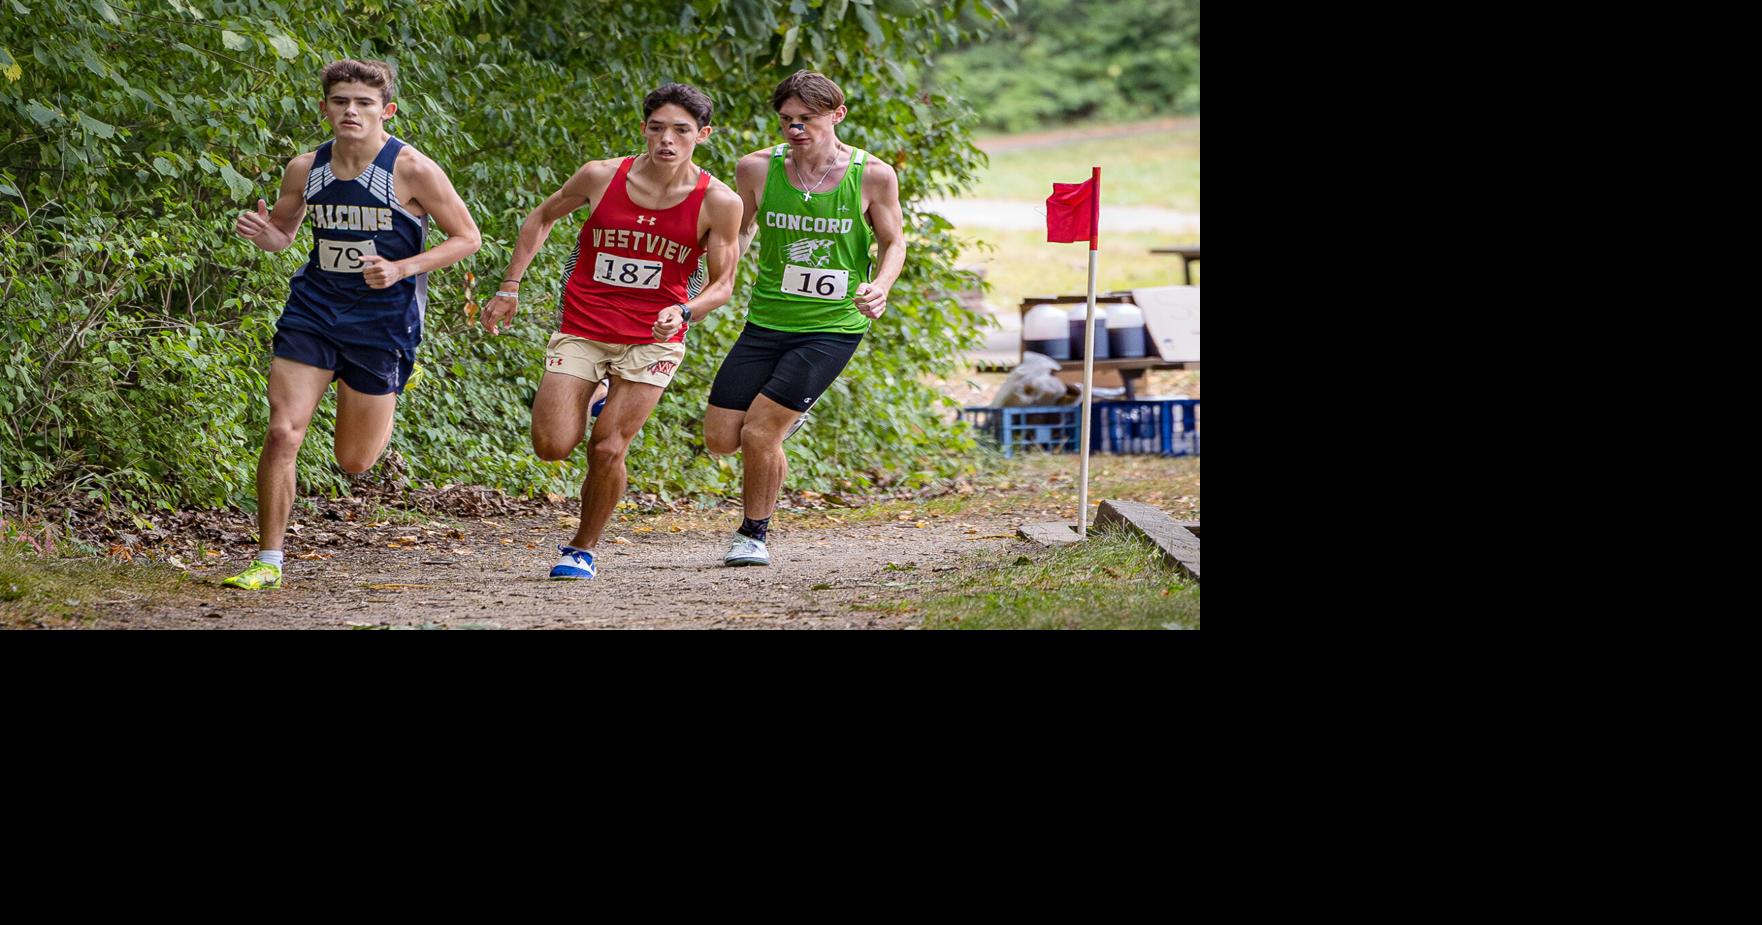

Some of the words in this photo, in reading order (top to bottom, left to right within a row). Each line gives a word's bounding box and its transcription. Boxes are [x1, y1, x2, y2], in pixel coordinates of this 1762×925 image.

[766, 211, 853, 234] CONCORD
[328, 246, 365, 269] 79
[592, 228, 692, 264] WESTVIEW
[601, 259, 662, 285] 187
[797, 272, 836, 296] 16
